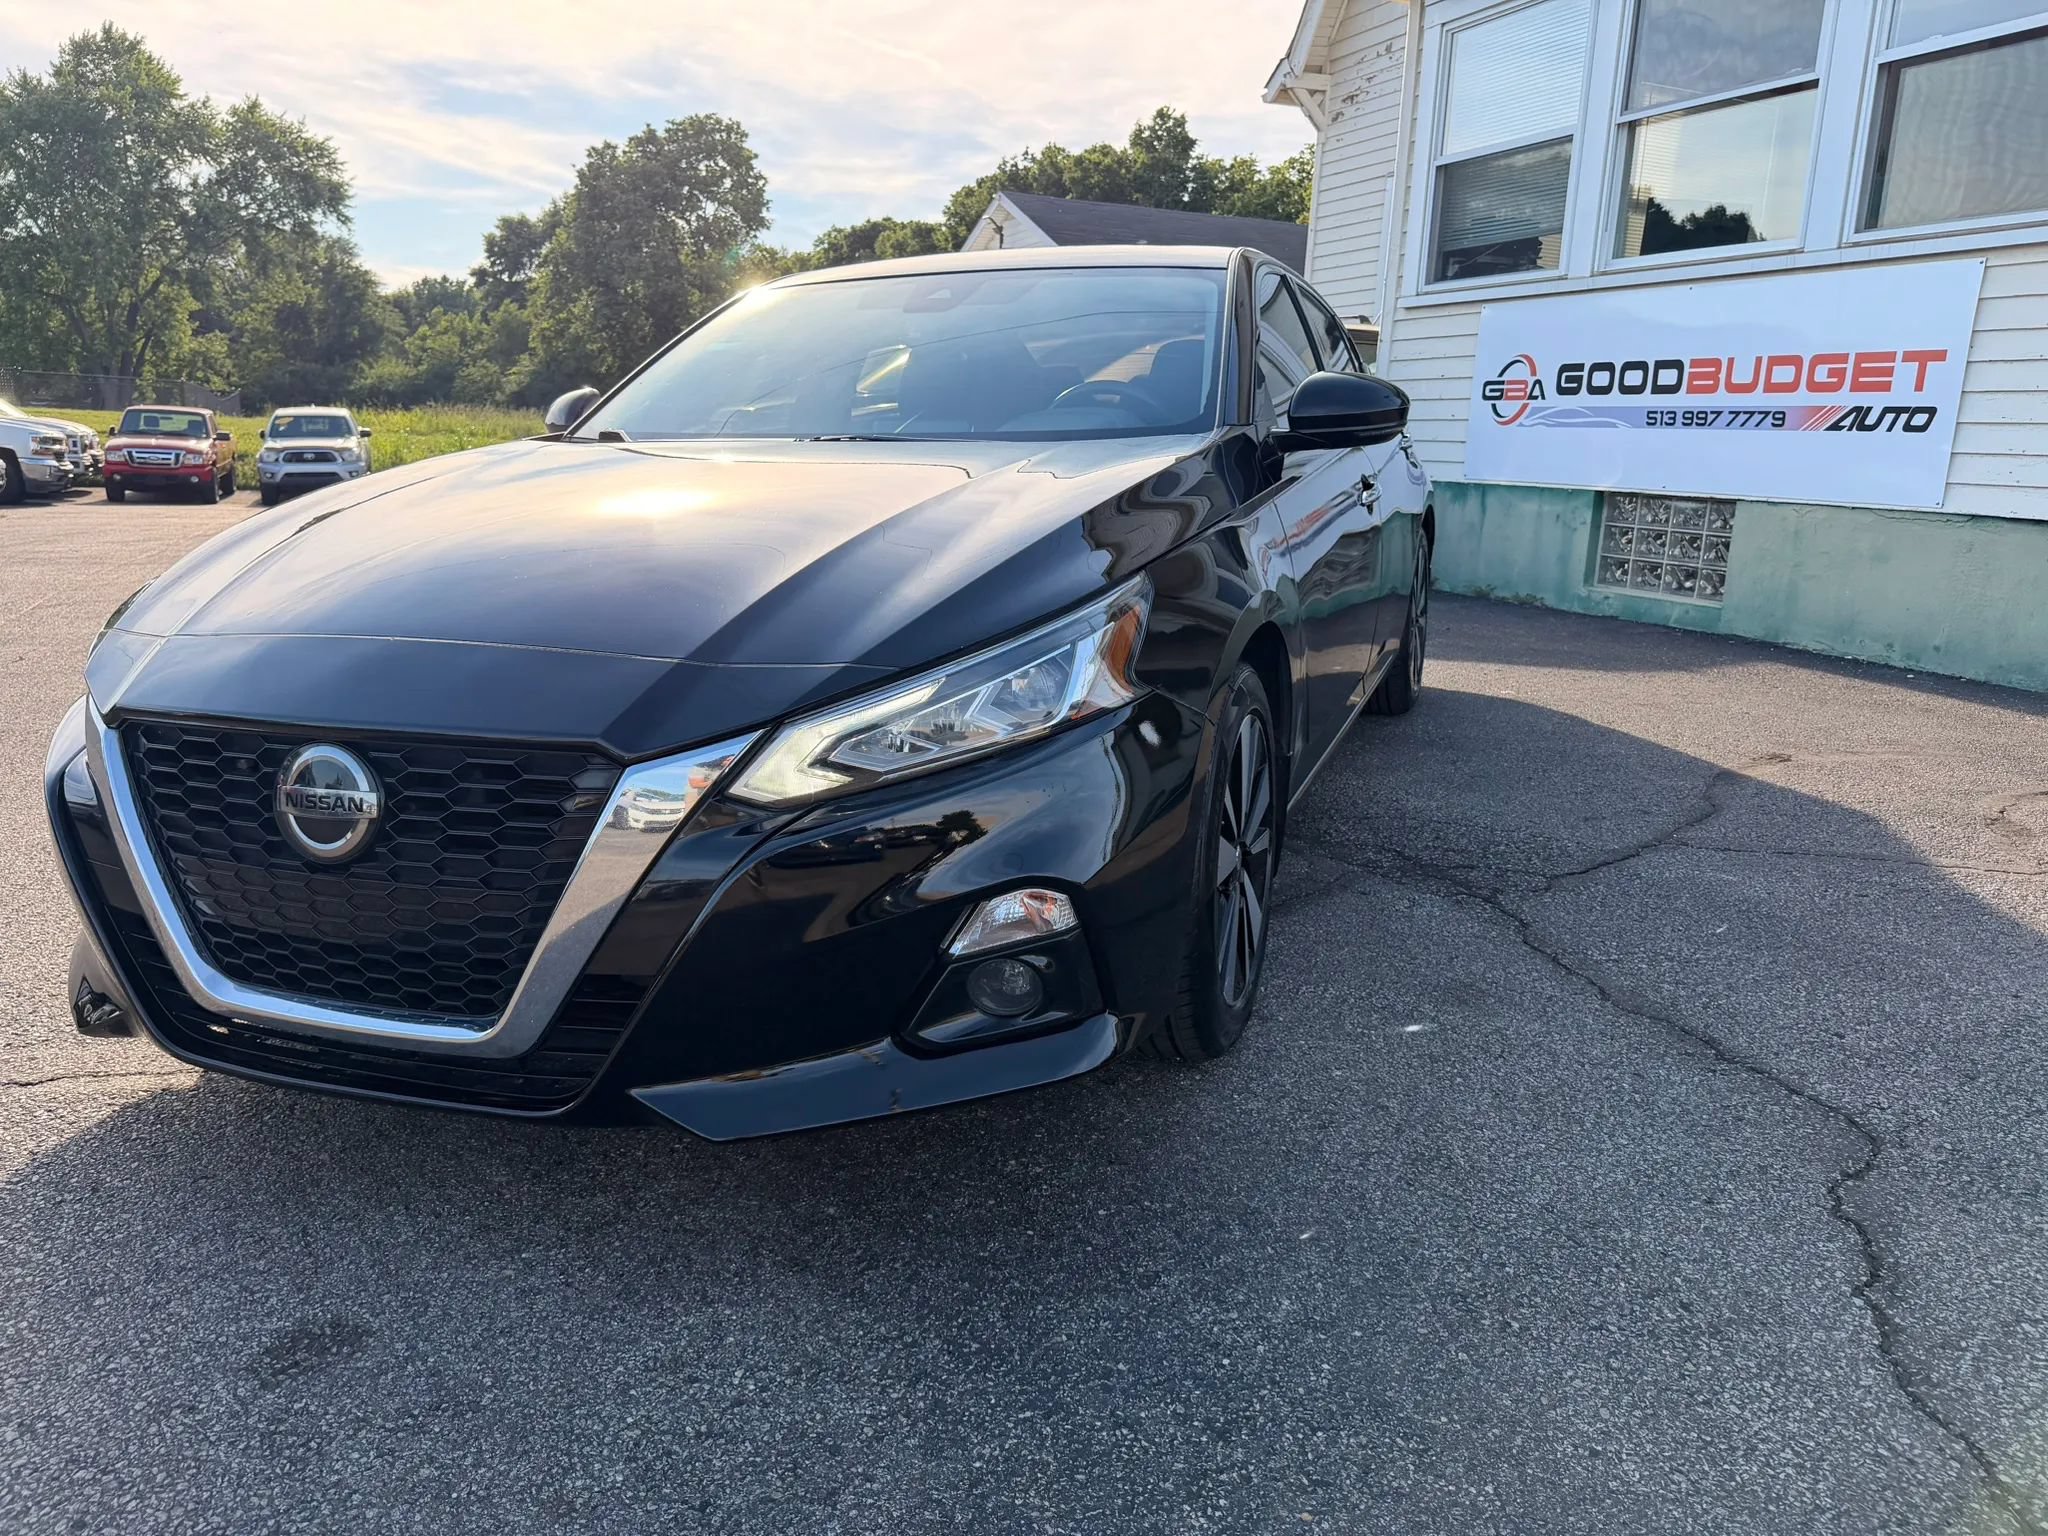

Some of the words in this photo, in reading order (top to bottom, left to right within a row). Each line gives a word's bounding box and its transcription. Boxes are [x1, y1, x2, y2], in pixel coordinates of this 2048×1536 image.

[1481, 377, 1546, 401] GBA
[1645, 410, 1677, 427] 513
[1681, 410, 1724, 427] 997
[1725, 410, 1786, 428] 7779
[1823, 405, 1938, 433] AUTO
[285, 792, 364, 813] NISSAN
